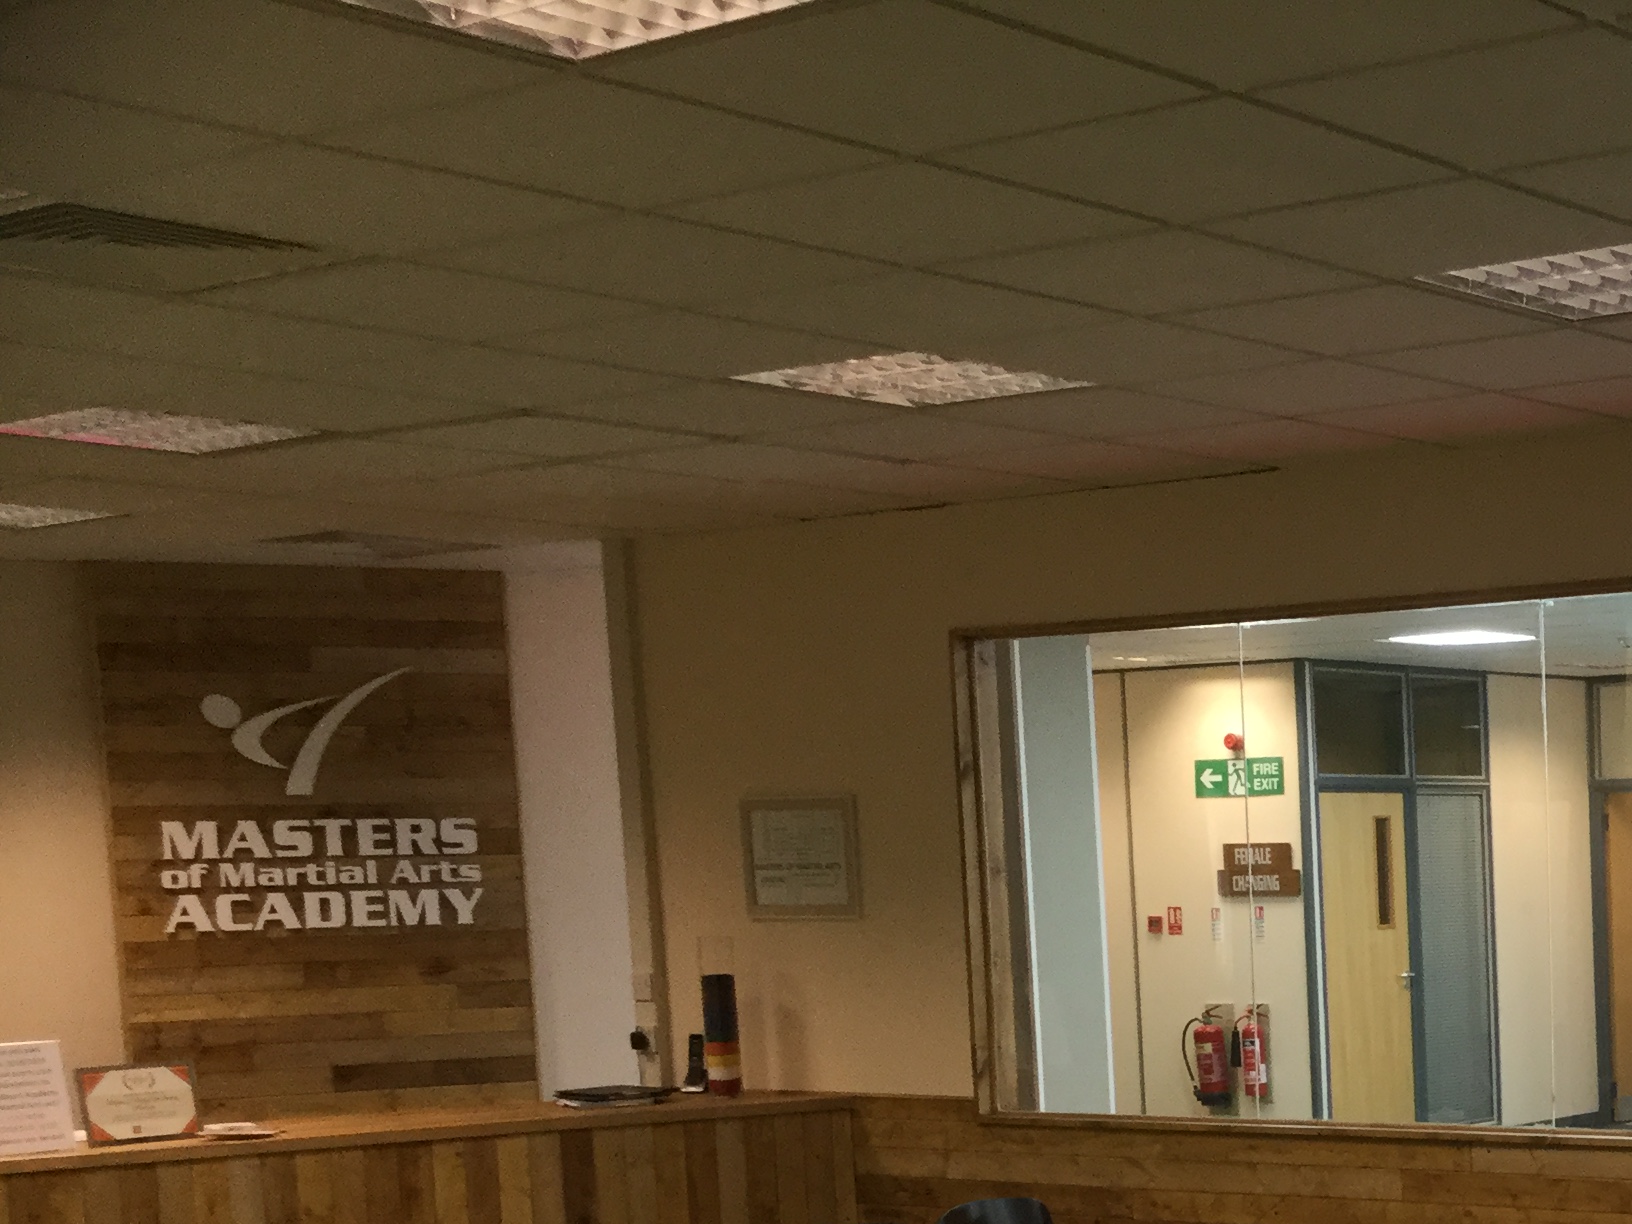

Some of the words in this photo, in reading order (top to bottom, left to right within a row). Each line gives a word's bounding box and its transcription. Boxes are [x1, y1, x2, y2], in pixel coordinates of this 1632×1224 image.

[1253, 763, 1279, 775] FIRE
[1253, 778, 1279, 791] EXIT
[160, 818, 478, 859] MASTERS
[1234, 848, 1272, 865] FEMALE
[160, 863, 209, 889] of
[218, 860, 378, 887] Martial
[389, 859, 483, 884] Arts
[1232, 875, 1280, 892] CHANGING
[164, 887, 483, 933] ACADEMY
